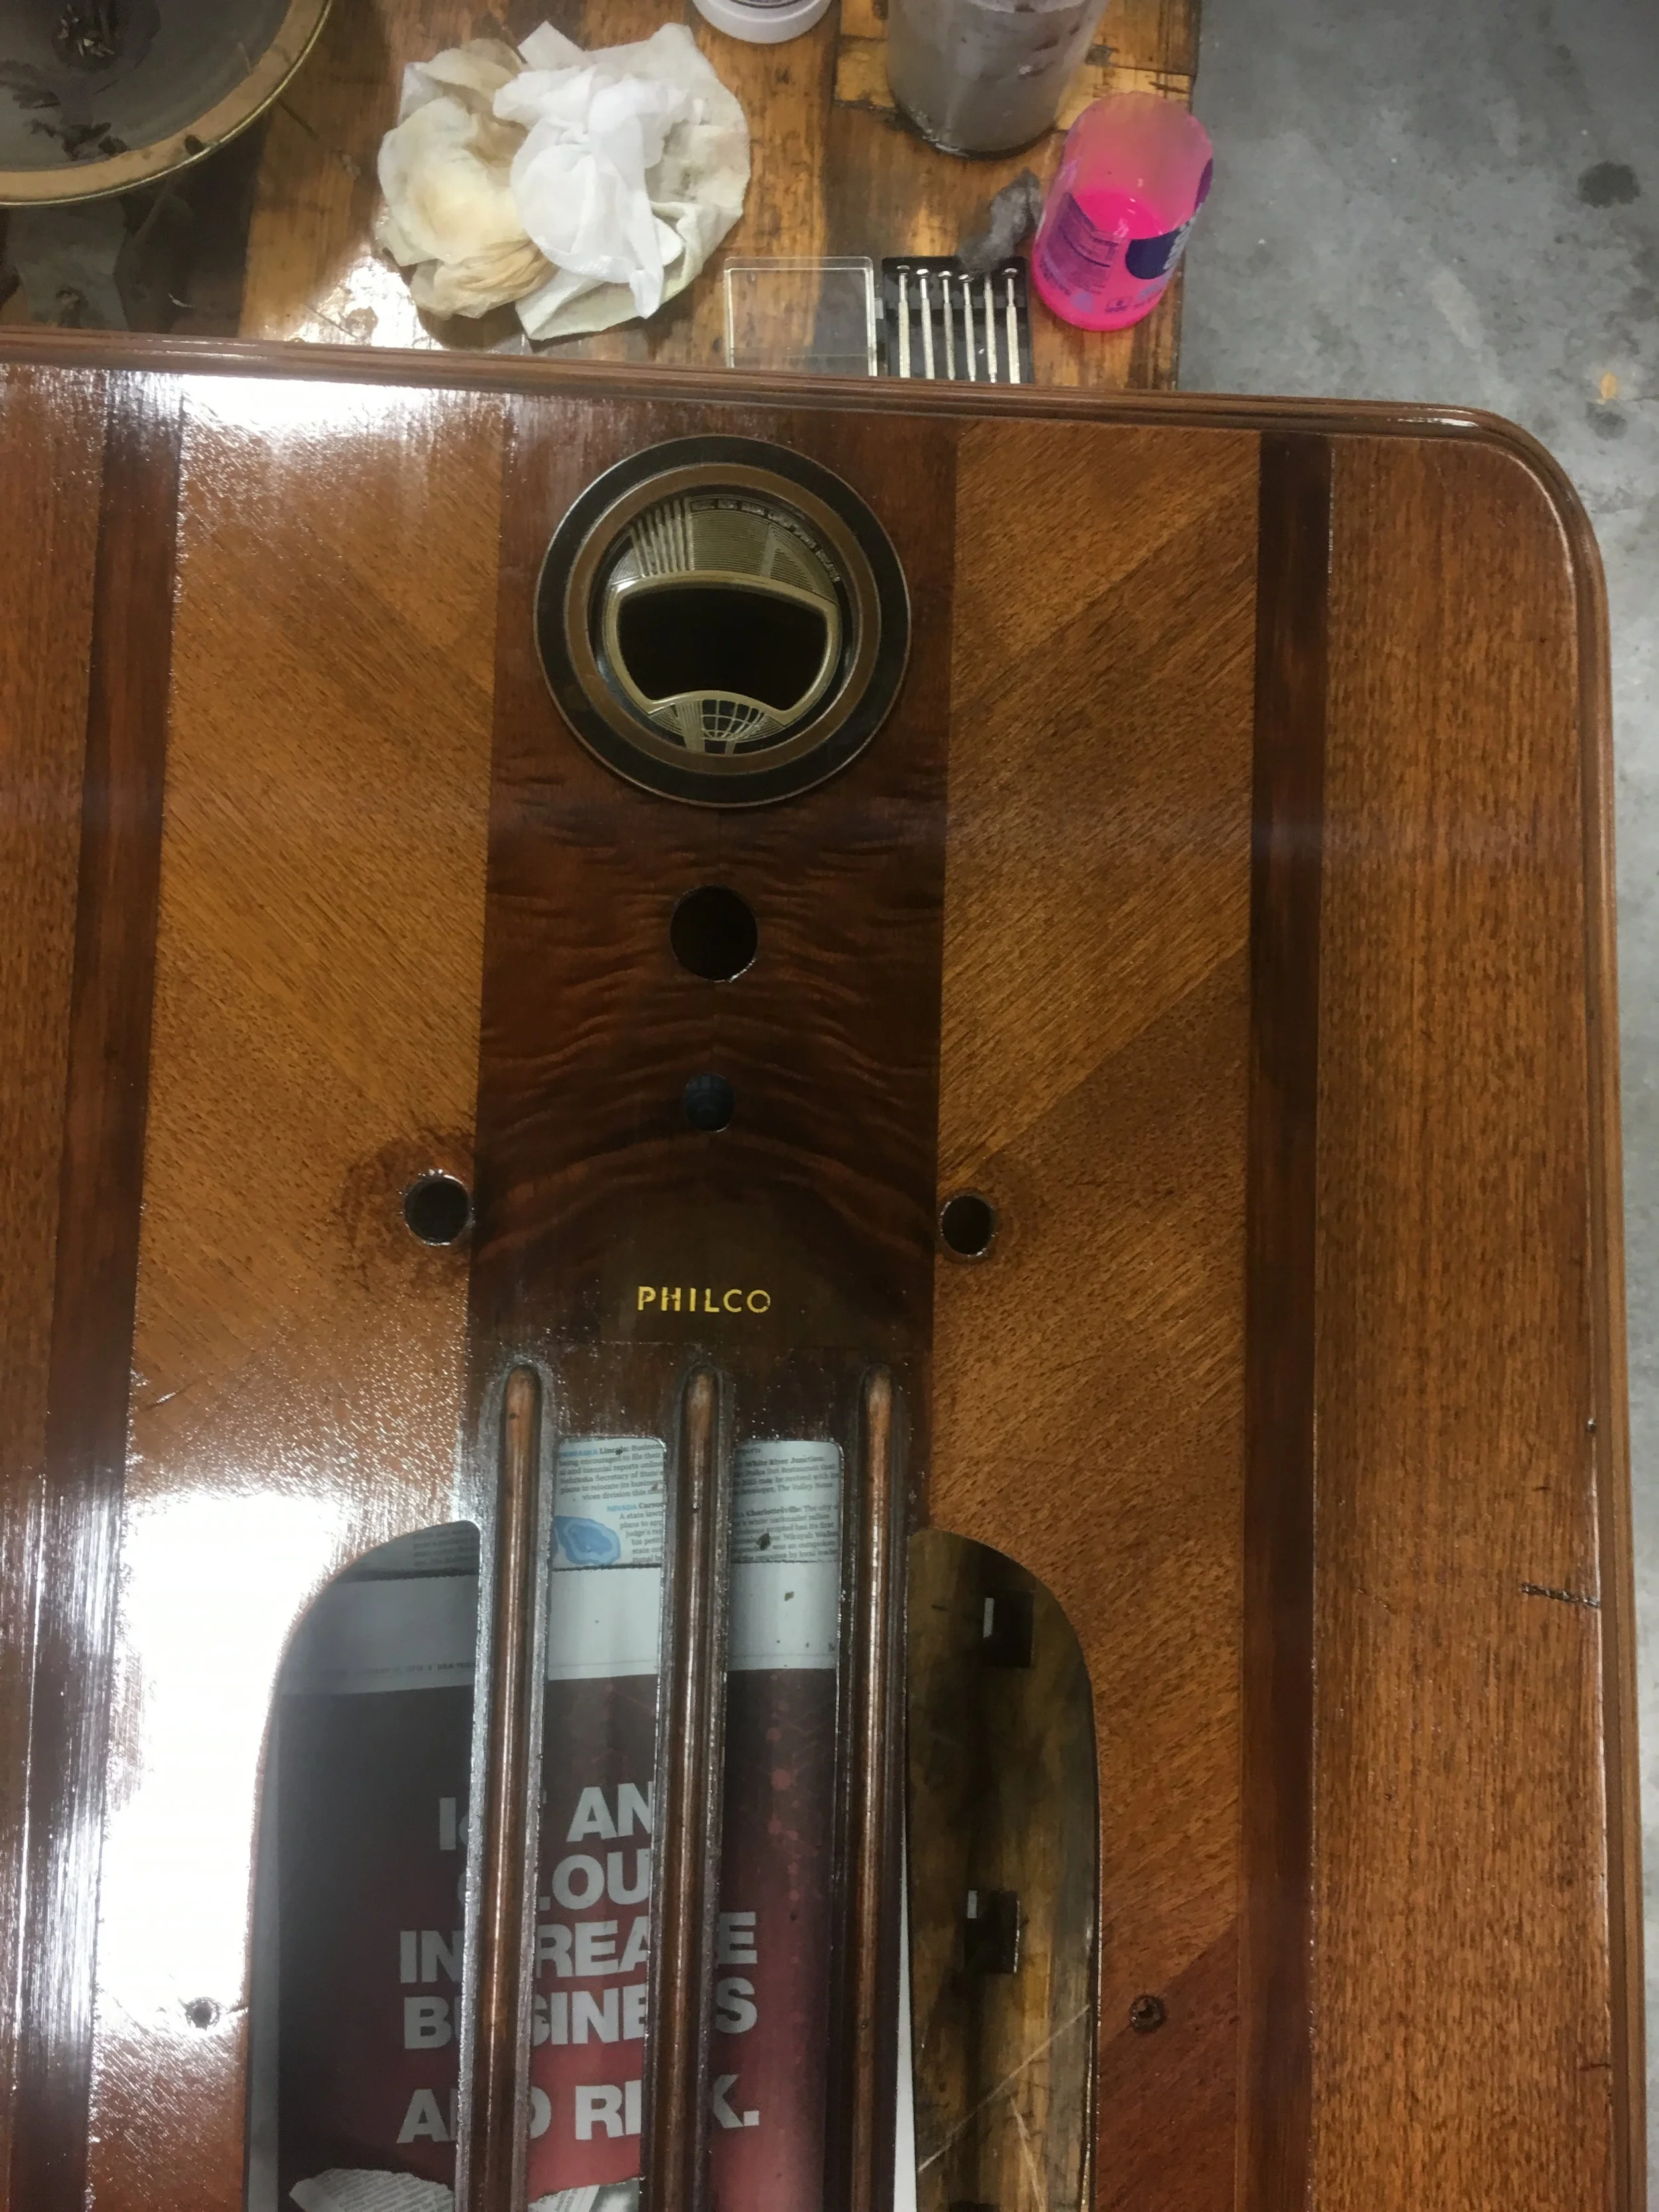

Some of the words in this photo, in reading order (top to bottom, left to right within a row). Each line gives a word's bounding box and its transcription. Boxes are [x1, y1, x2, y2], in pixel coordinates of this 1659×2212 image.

[638, 1286, 770, 1313] PHILCO
[566, 1781, 654, 1842] AN
[400, 1911, 757, 1983] INREAE
[404, 1977, 757, 2049] BINES
[575, 2075, 759, 2140] RIK.
